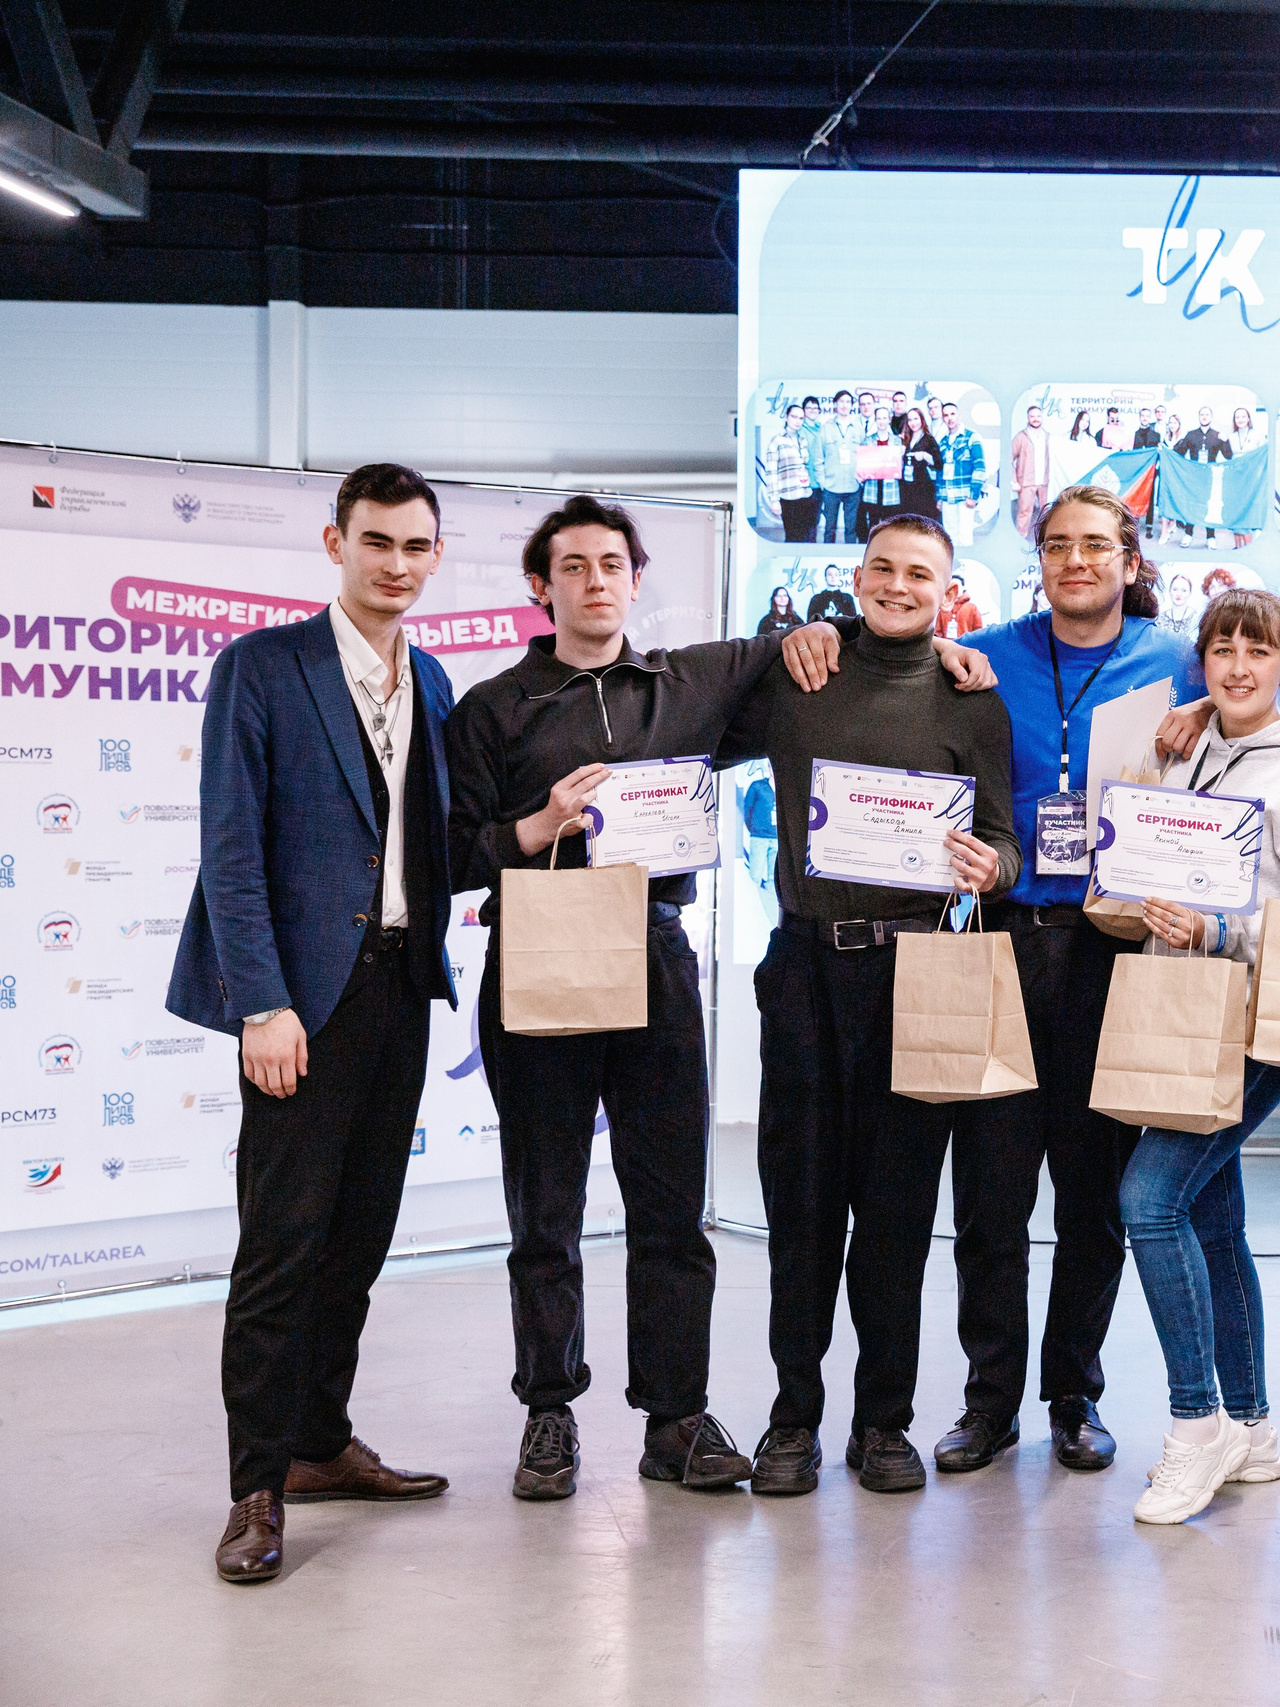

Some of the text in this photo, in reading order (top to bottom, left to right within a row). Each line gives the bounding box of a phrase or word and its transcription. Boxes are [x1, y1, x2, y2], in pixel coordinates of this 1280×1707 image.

[127, 587, 318, 627] МЕЖРЕГИО
[620, 786, 688, 801] СЕРТИФИКАТ
[849, 793, 934, 811] СЕРТИФИКАТ
[872, 808, 904, 816] УЧАСТНИКА
[1137, 813, 1222, 833] СЕРТИФИКАТ
[1159, 829, 1192, 837] УЧАСТНИКА
[1, 1108, 57, 1123] РСМ73
